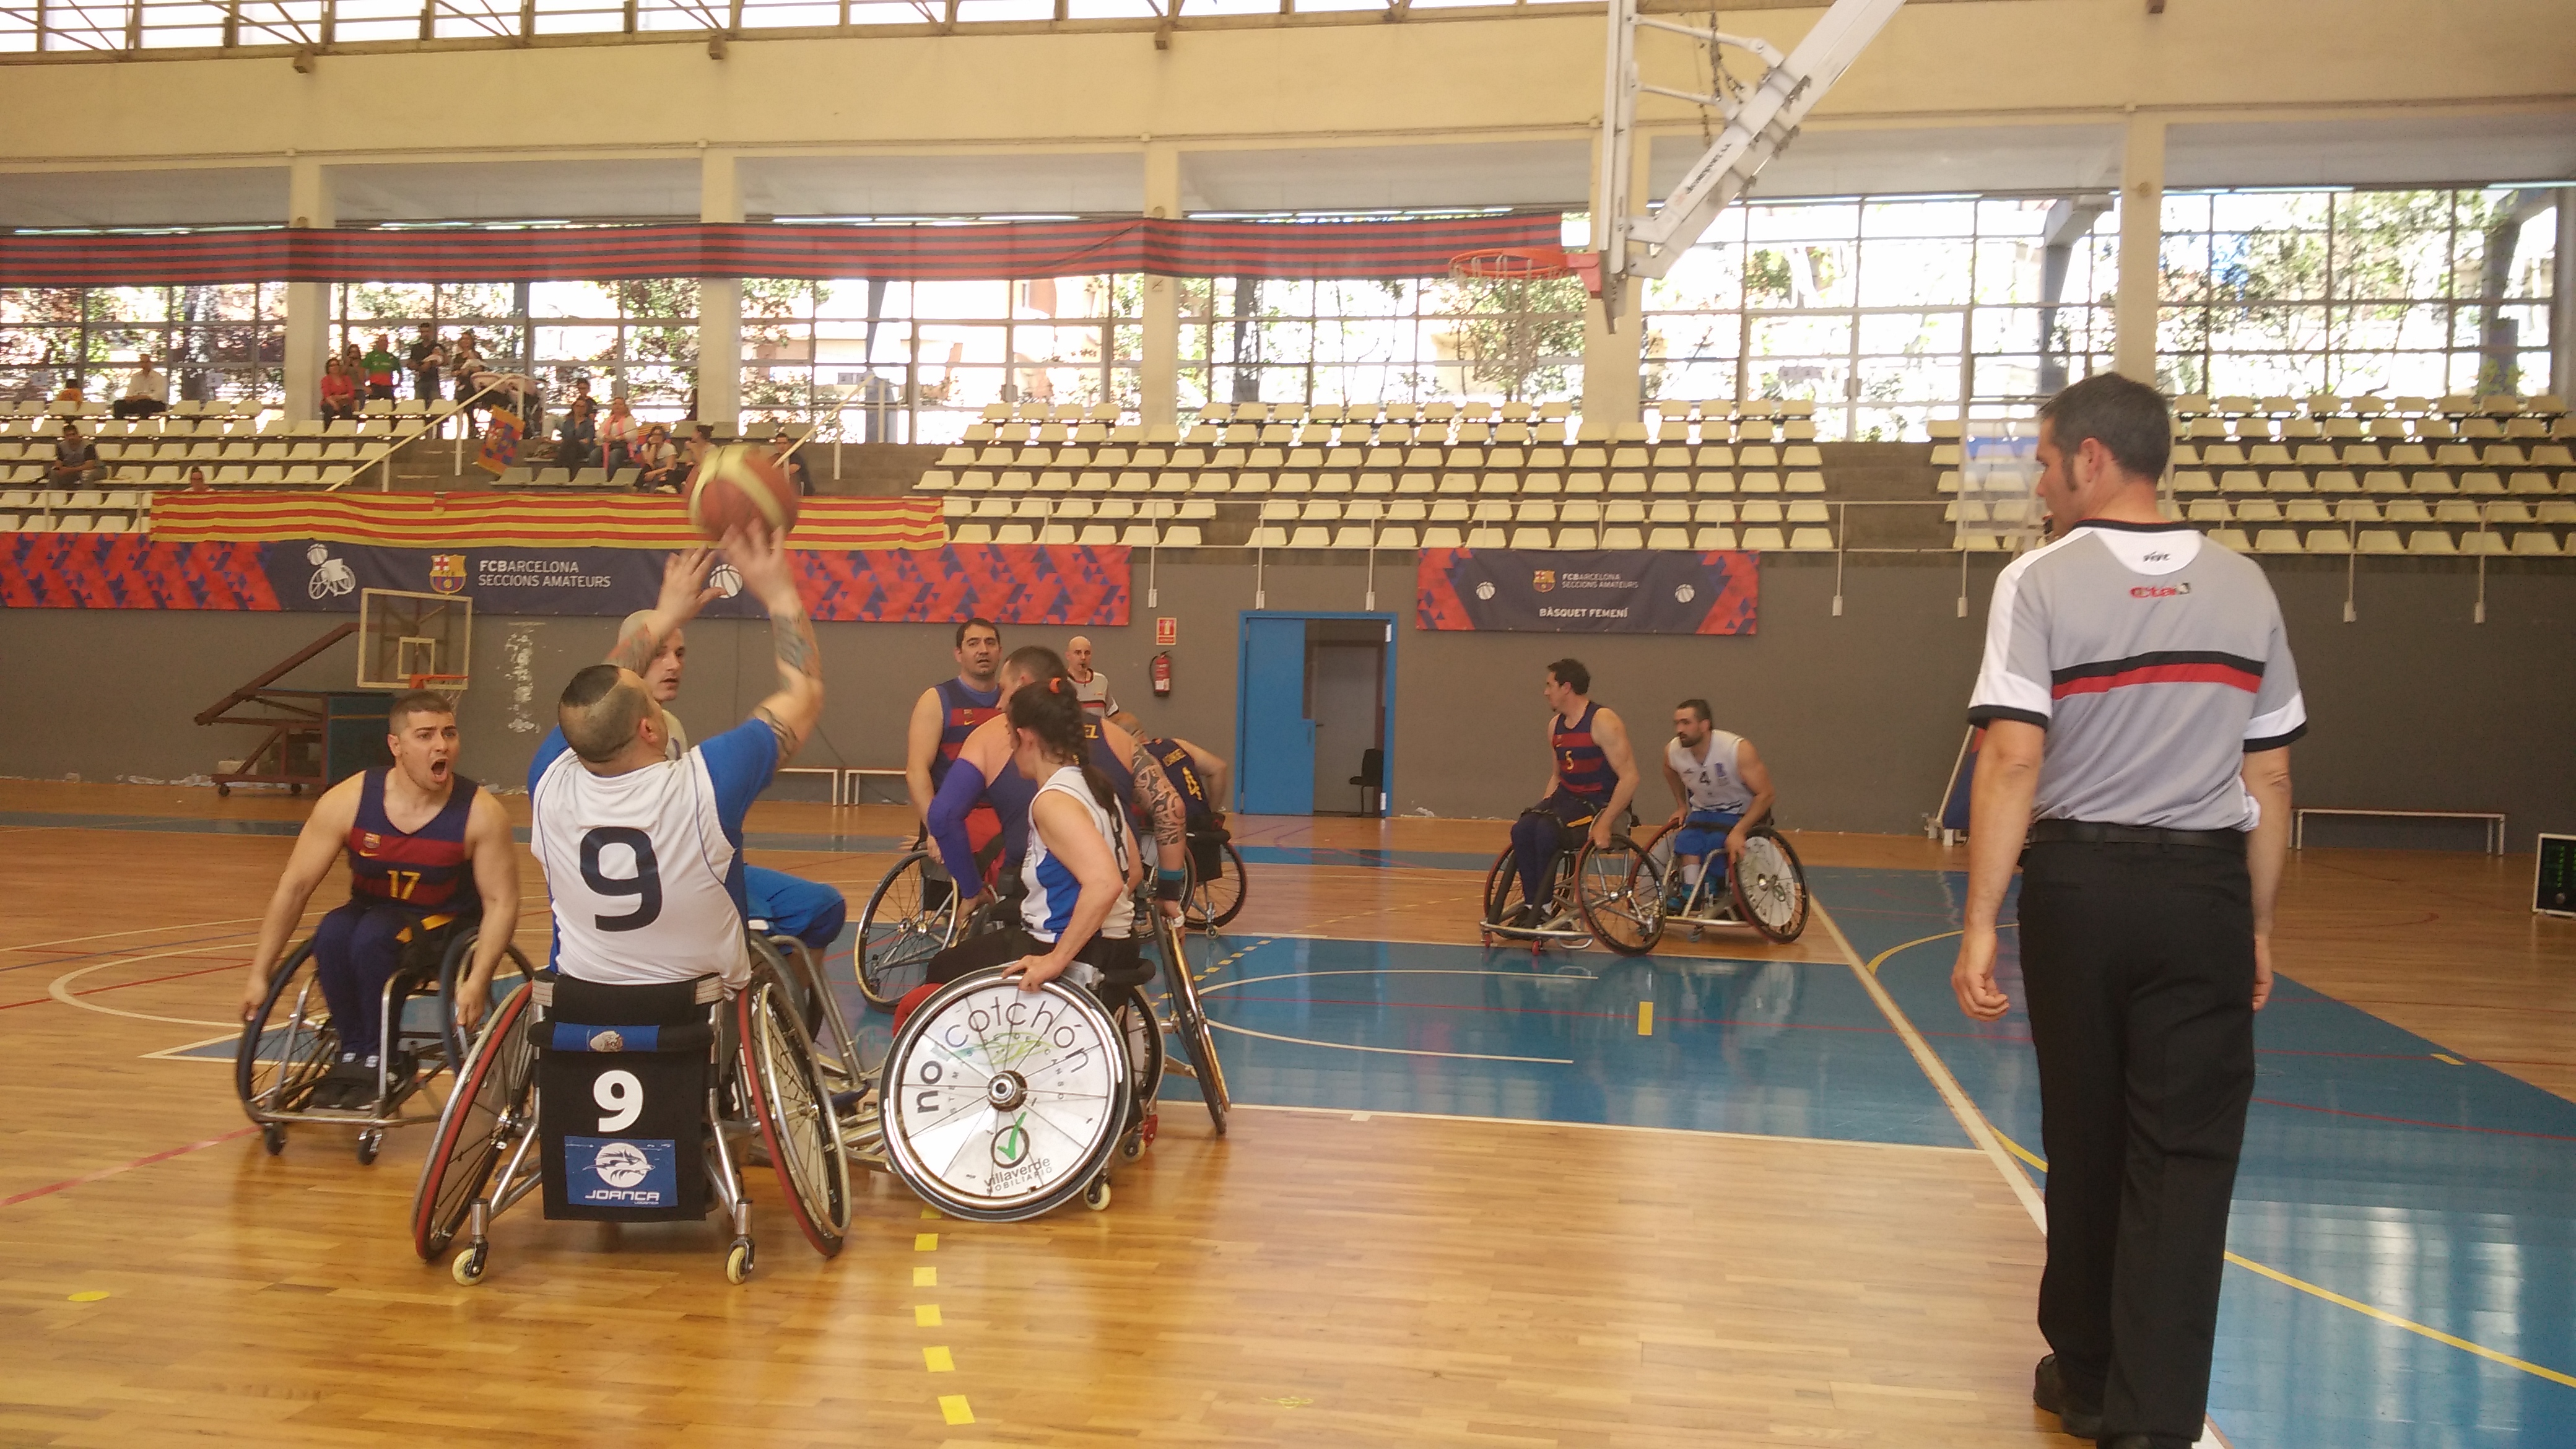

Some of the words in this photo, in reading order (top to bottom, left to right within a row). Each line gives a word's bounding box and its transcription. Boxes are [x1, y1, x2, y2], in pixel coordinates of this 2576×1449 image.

[479, 560, 580, 573] FCBARCELONA
[478, 574, 540, 587] SECCIONS
[542, 575, 612, 588] AMATEURS
[1562, 573, 1621, 581] FCBARCELONA
[1561, 581, 1598, 589] SECCIONS
[1598, 581, 1639, 589] AMATEURS
[1539, 606, 1588, 617] BÀSQUET
[1589, 607, 1629, 618] FEMENÍ
[1564, 750, 1575, 771] 5
[1699, 771, 1712, 786] 4
[386, 869, 422, 900] 17
[580, 826, 663, 932] 9
[916, 1060, 943, 1114] no
[593, 1069, 643, 1133] 9
[983, 1157, 1051, 1187] villaverde
[584, 1190, 660, 1201] JOANCA
